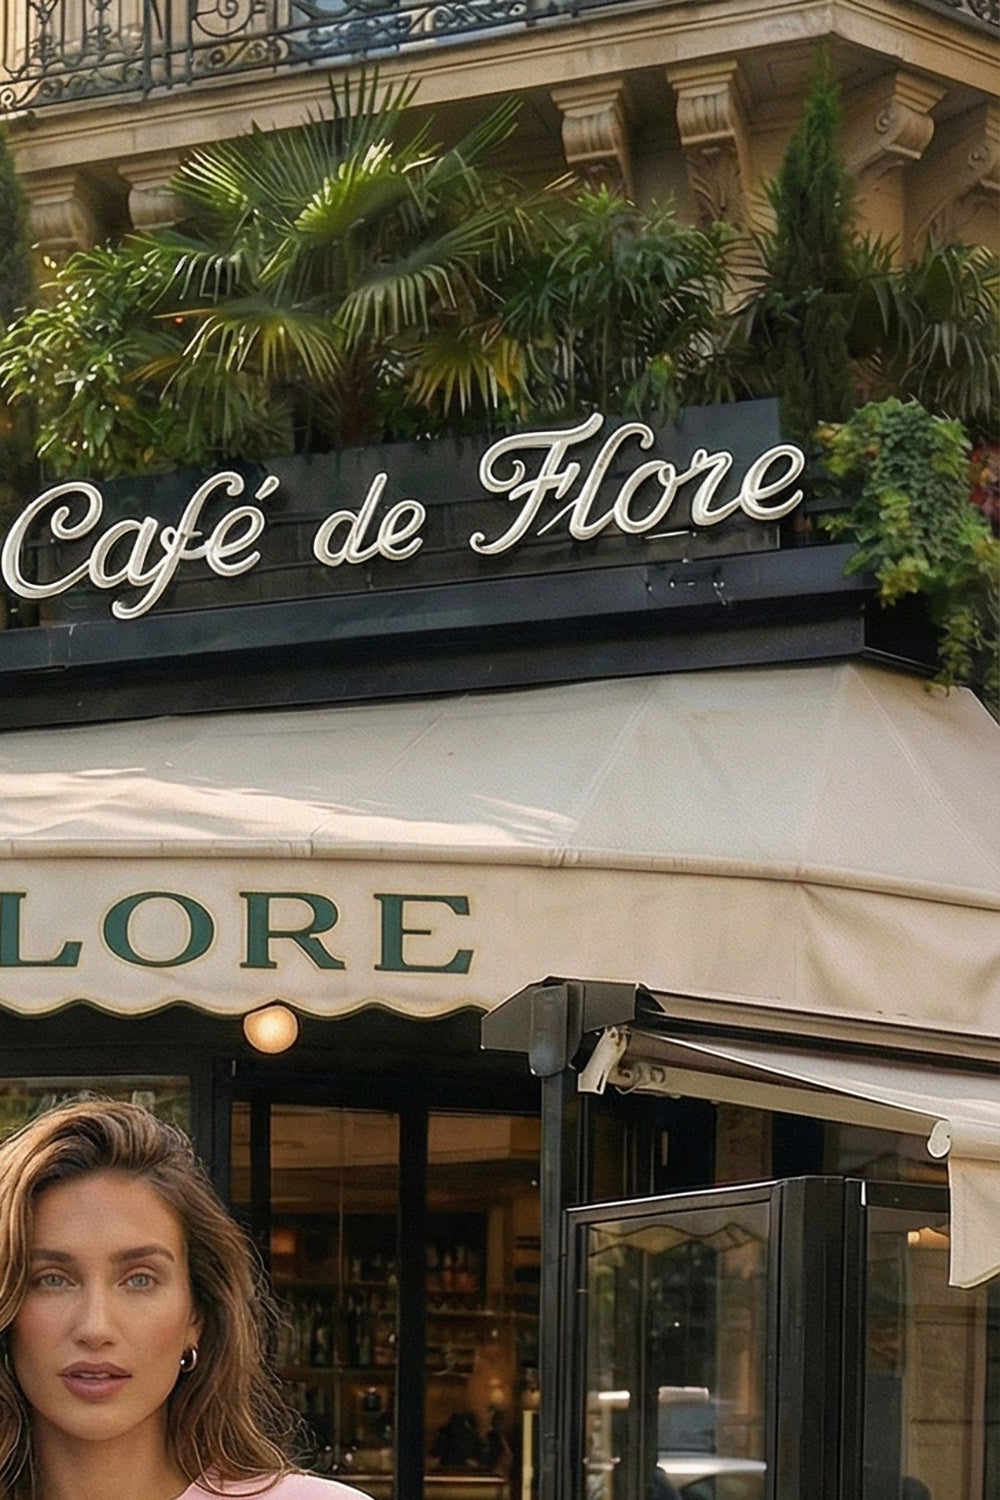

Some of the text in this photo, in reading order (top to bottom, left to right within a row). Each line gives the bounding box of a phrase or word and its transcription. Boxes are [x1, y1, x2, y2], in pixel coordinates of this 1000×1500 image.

[1, 411, 805, 620] Café de Flore
